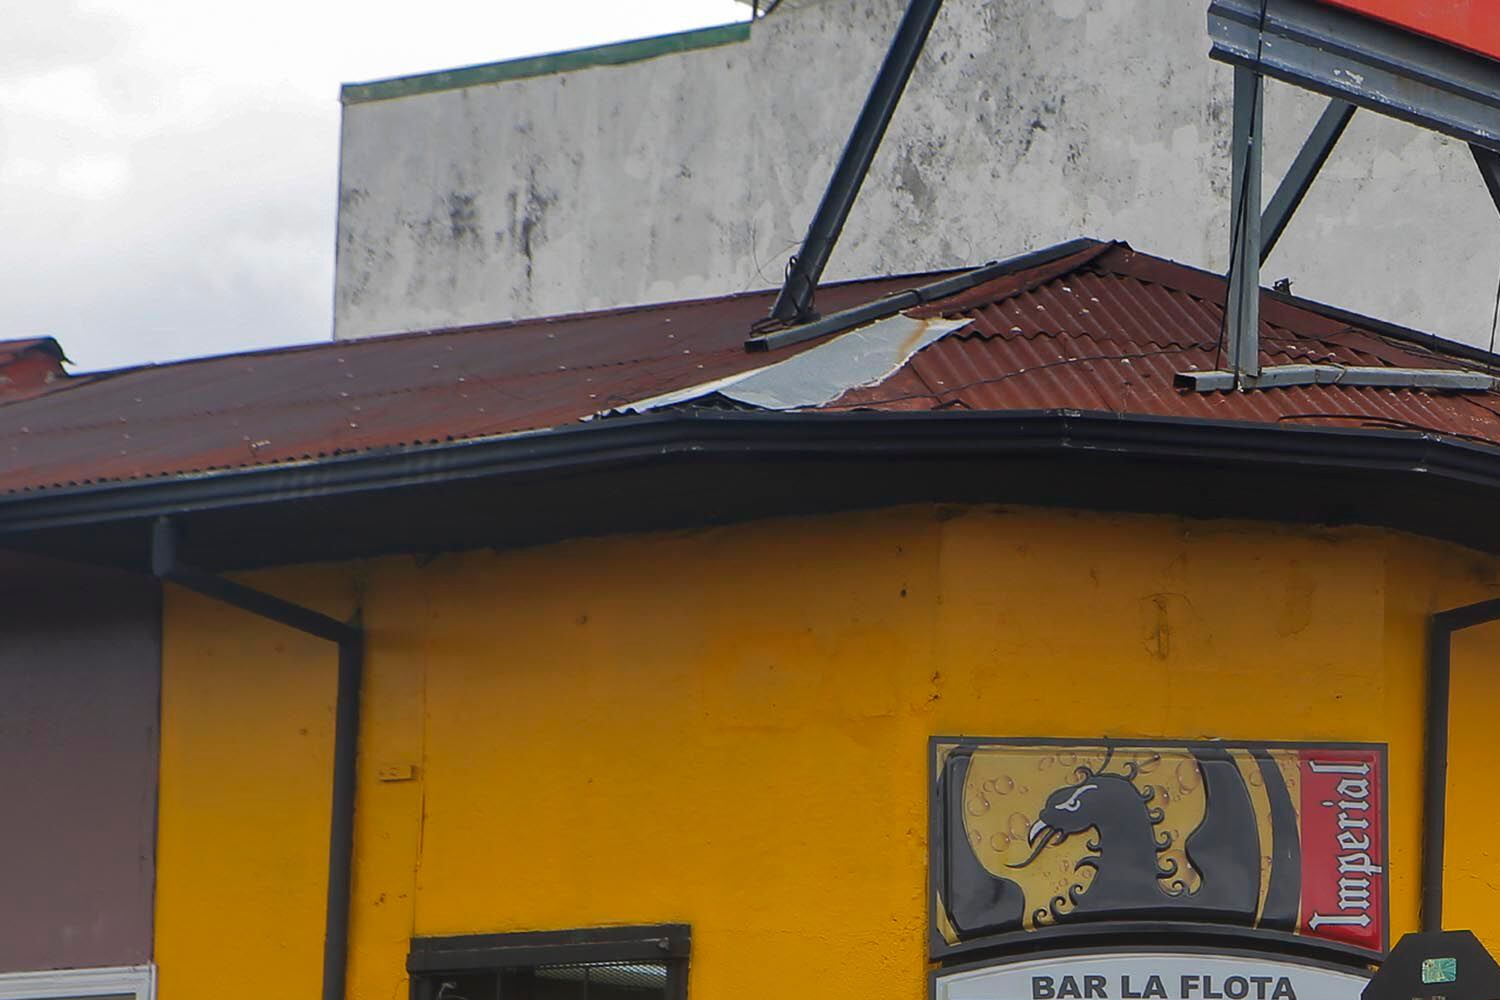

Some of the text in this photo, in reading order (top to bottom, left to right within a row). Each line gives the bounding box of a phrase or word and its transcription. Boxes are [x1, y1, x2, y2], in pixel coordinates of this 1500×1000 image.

[1308, 758, 1382, 932] Imperial
[1031, 975, 1297, 1000] BAR LA FLOTA
